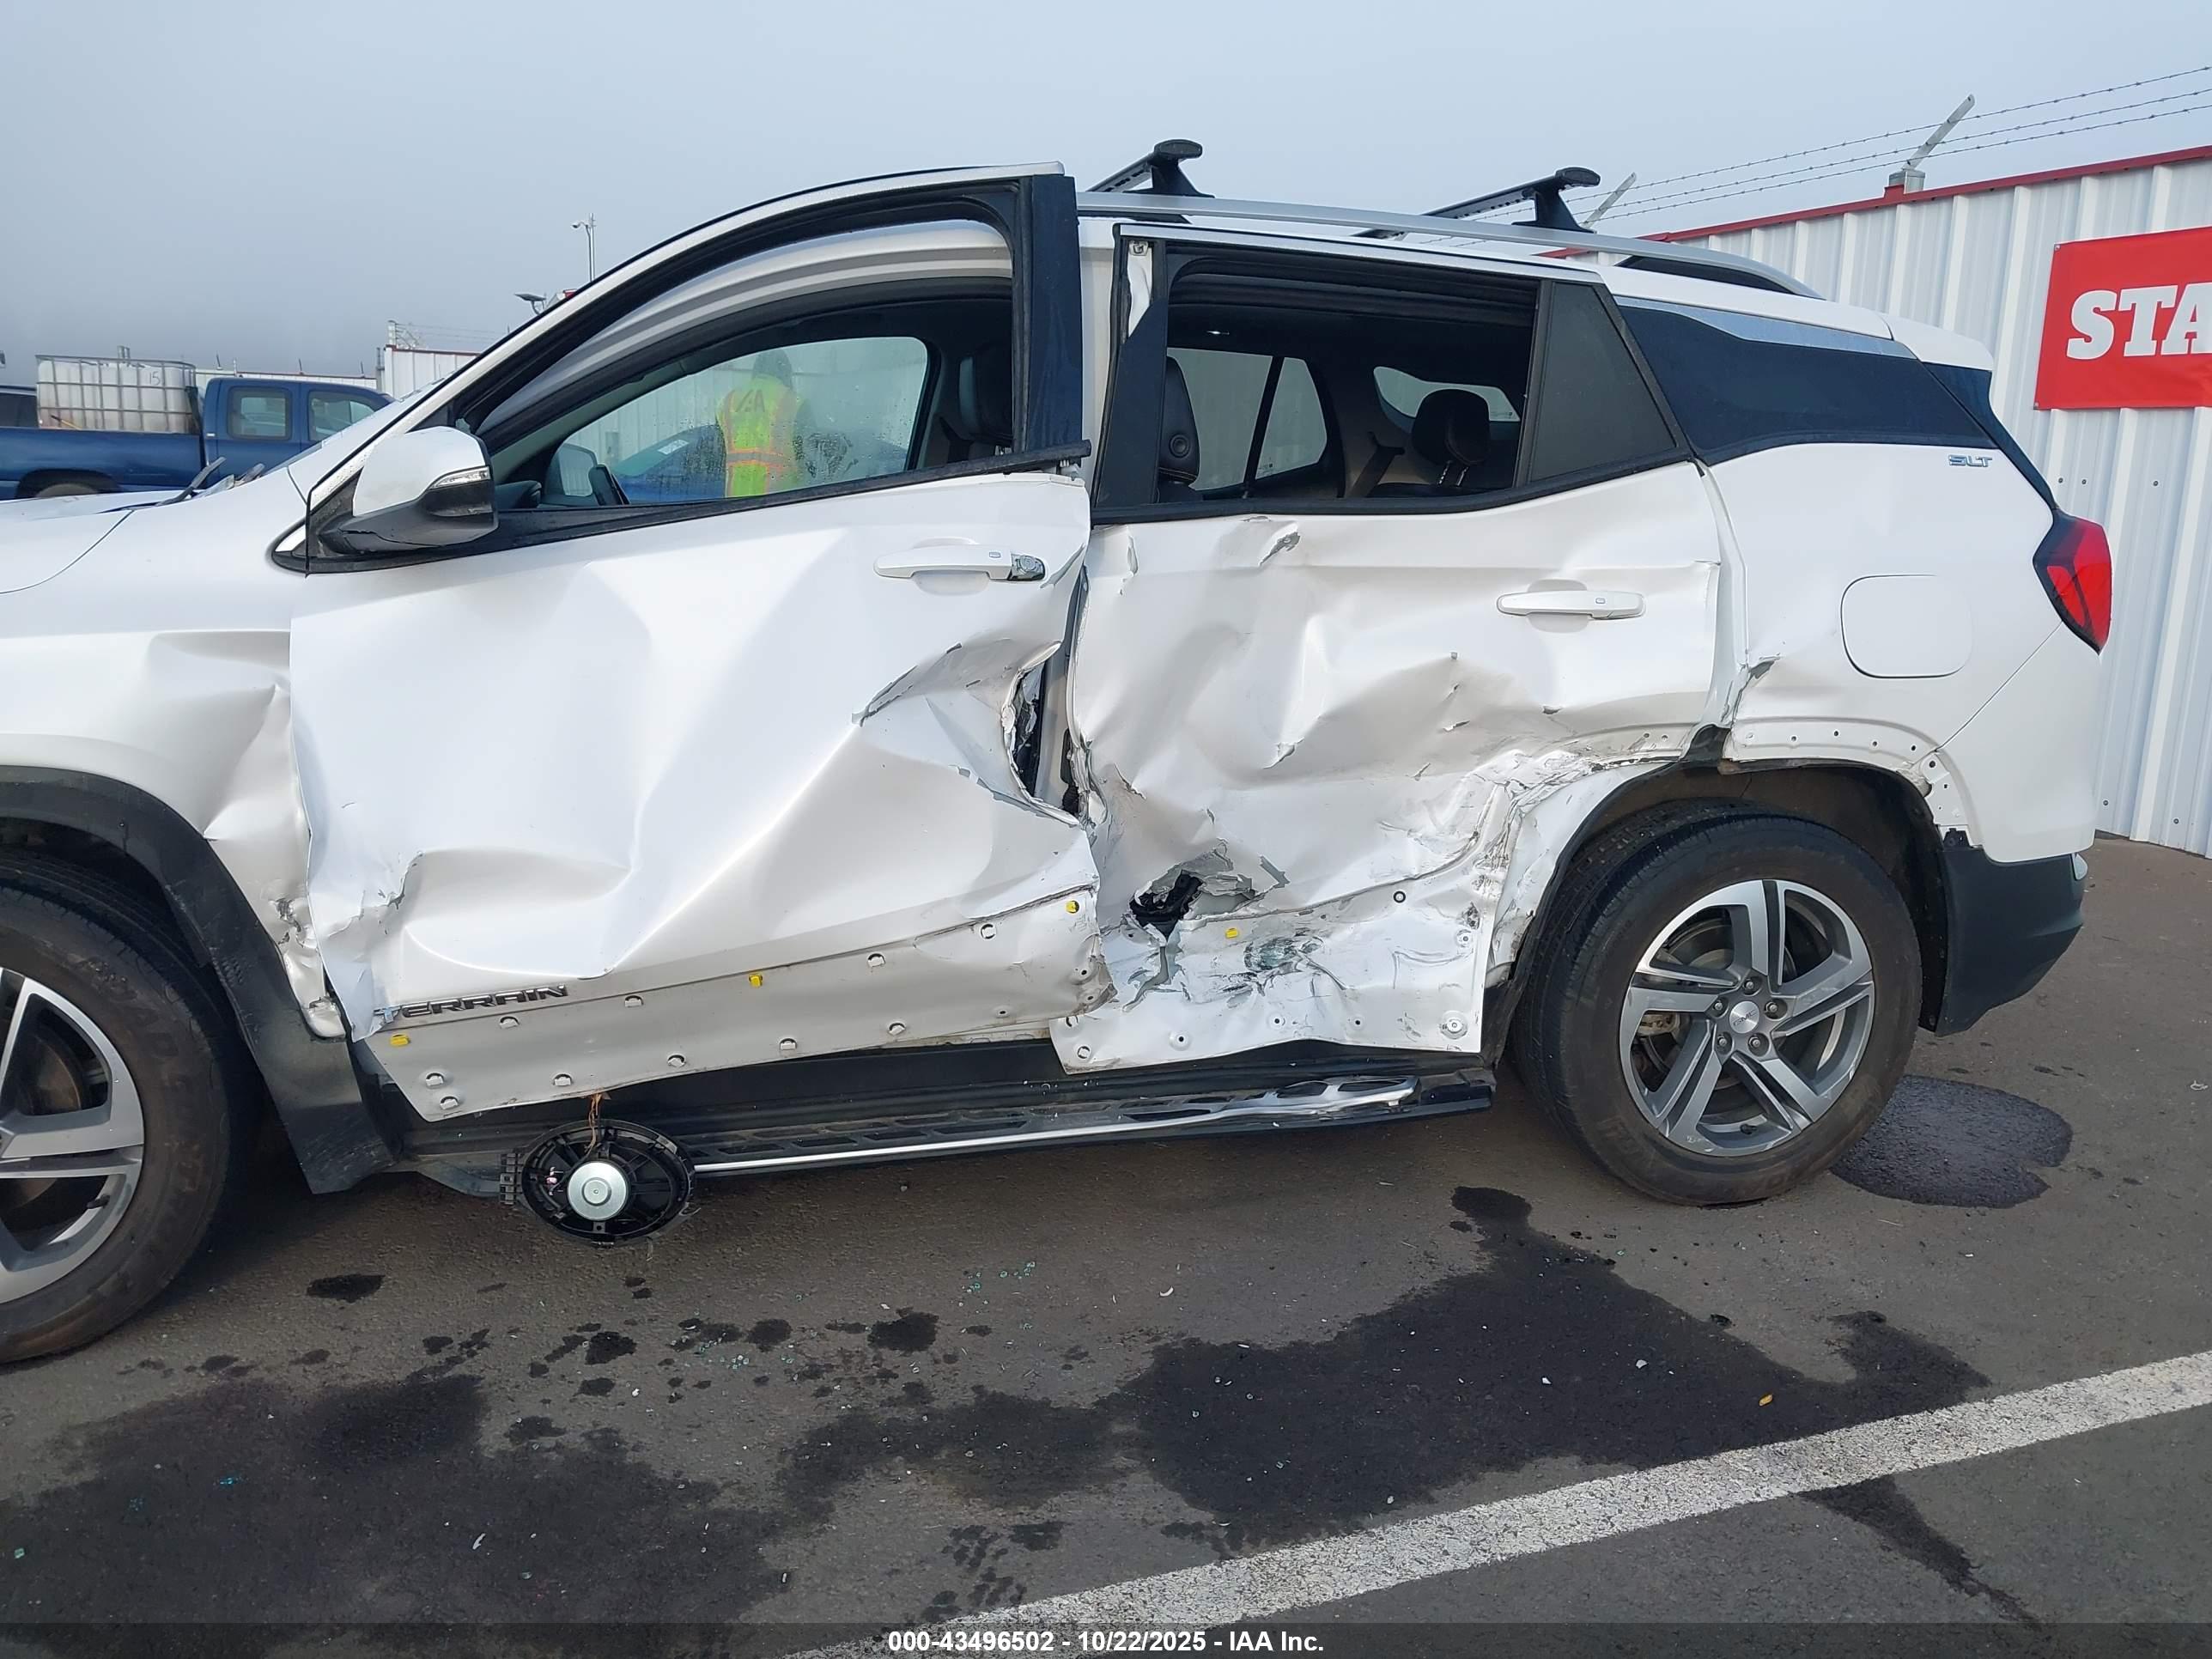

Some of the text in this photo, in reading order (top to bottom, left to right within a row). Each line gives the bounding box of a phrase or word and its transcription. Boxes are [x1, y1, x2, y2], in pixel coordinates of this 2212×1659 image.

[2066, 282, 2212, 360] STA
[1948, 454, 1993, 468] SLT
[374, 984, 568, 1024] TERRAIN
[1733, 1009, 1757, 1026] GMC
